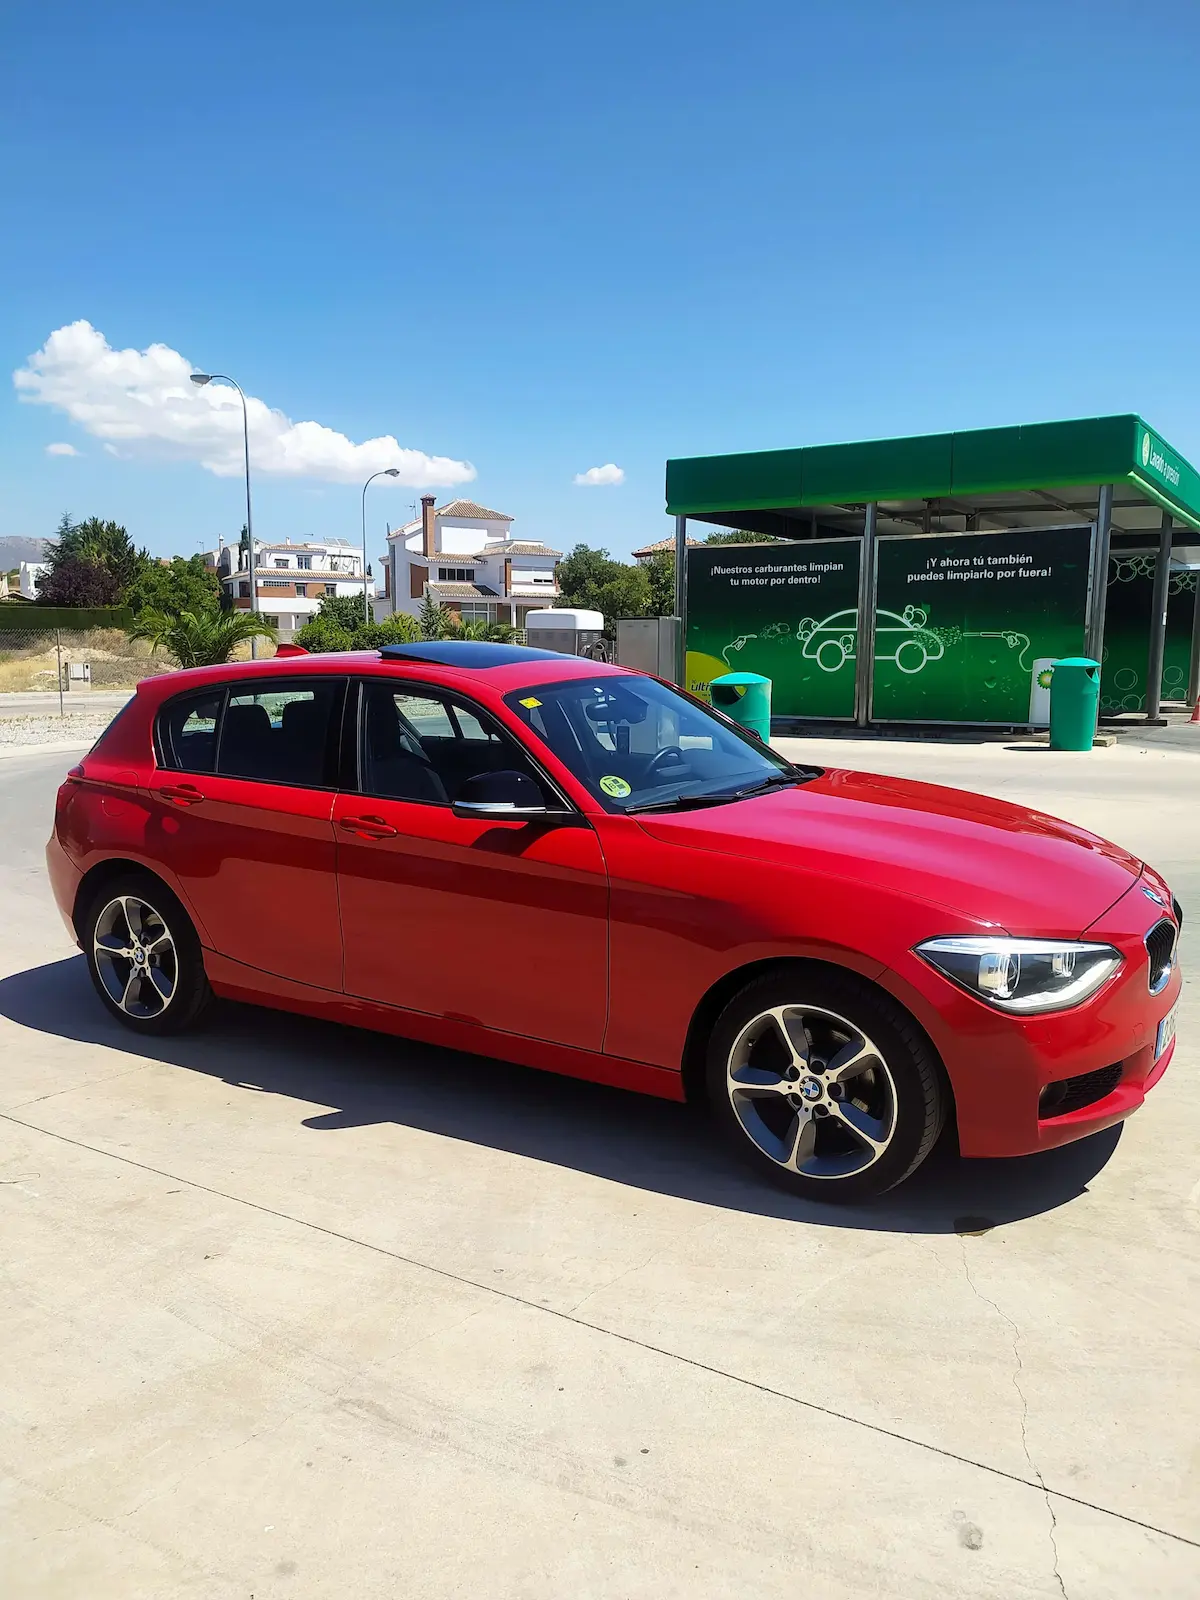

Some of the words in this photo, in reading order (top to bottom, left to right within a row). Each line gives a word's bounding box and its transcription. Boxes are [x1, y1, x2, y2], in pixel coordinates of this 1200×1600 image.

[926, 557, 938, 569] ¡Y
[940, 557, 970, 567] ahora
[972, 555, 984, 566] tú
[986, 553, 1033, 565] también
[710, 566, 752, 576] ¡Nuestros
[754, 564, 807, 574] carburantes
[809, 562, 844, 573] limpian
[907, 571, 944, 583] puedes
[947, 569, 994, 581] limpiarlo
[997, 569, 1016, 580] por
[1018, 567, 1052, 578] fuera!
[730, 577, 739, 586] tu
[741, 577, 768, 586] motor
[770, 577, 786, 587] por
[787, 575, 821, 585] dentro!
